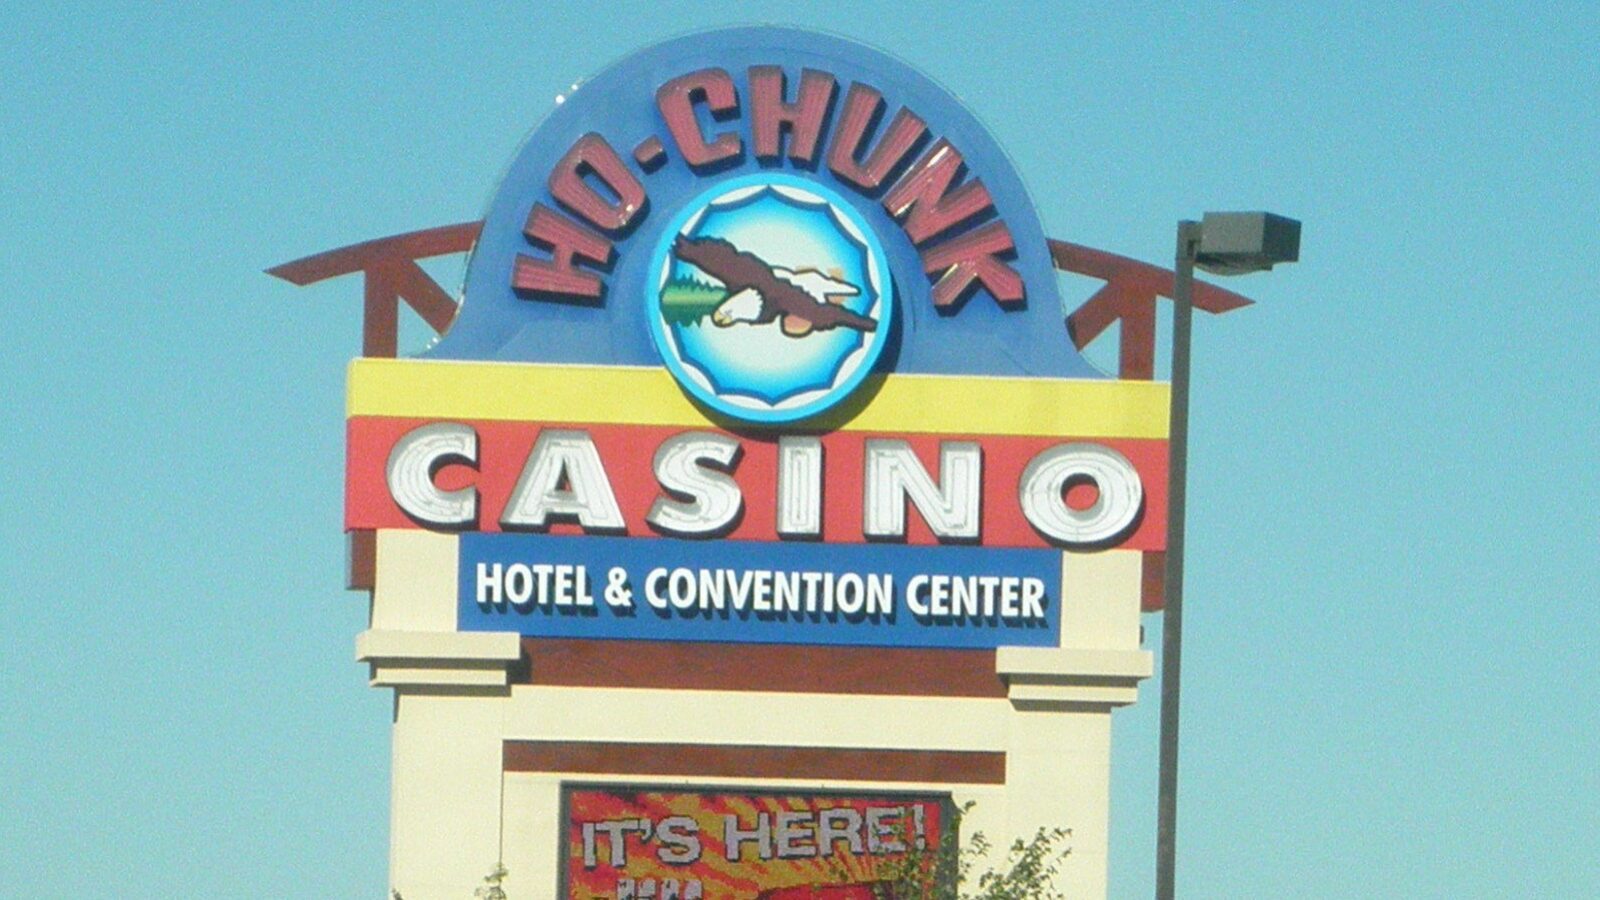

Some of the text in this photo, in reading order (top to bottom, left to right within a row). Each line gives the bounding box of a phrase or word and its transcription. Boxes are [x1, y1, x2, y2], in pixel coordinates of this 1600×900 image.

[511, 65, 1027, 316] HO-CHUNK
[385, 421, 1144, 545] CASINO
[476, 562, 1046, 619] HOTEL & CONVENTION CENTER
[582, 804, 926, 868] IT'S HERE!
